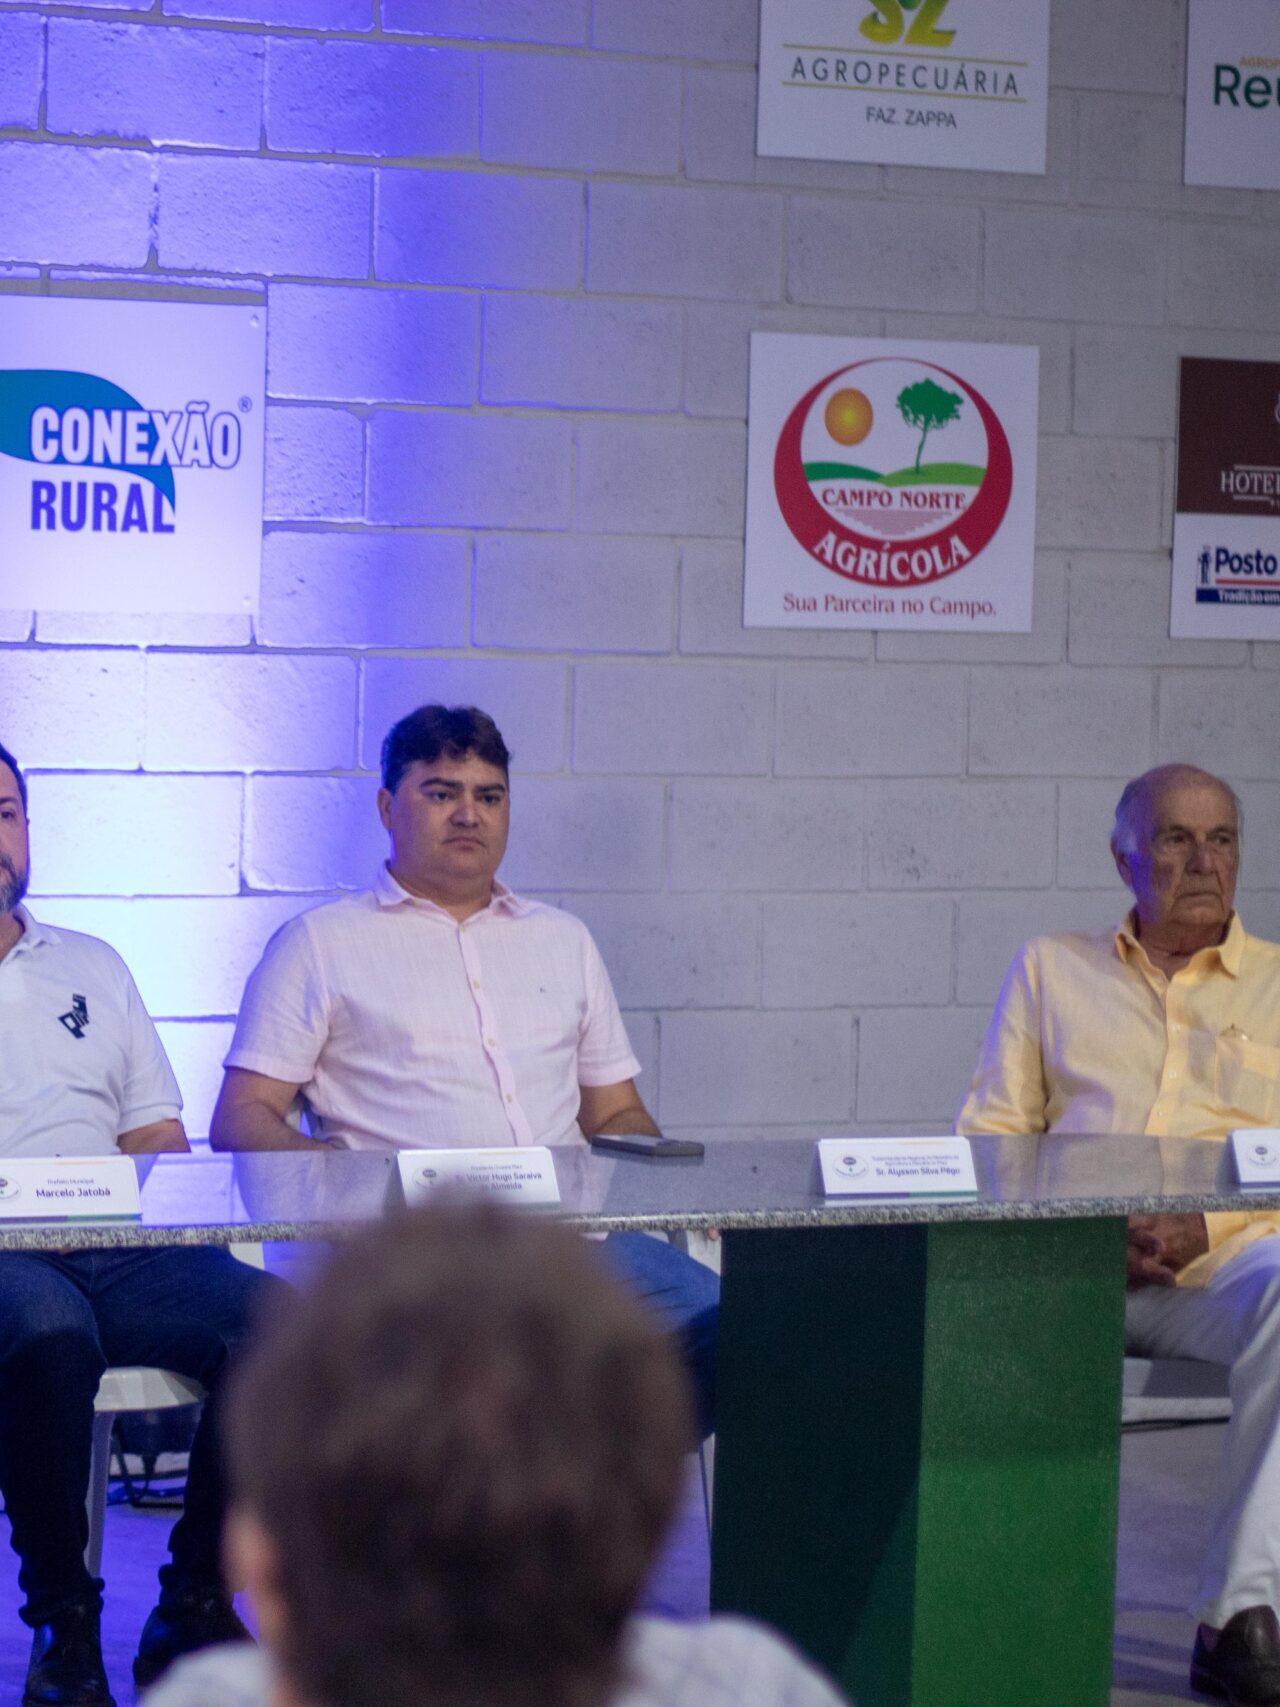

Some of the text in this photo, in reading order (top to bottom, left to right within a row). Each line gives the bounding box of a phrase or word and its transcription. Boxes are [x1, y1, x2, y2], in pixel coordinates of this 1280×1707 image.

[790, 57, 1020, 95] AGROPECUÁRIA
[1214, 63, 1280, 109] Re
[866, 105, 958, 130] FAZ. ZAPPA
[29, 400, 241, 470] CONEXÃO
[31, 480, 176, 533] RURAL
[822, 488, 966, 511] CAMPO NORTE
[814, 530, 972, 582] AGRÍCOLA
[1215, 548, 1277, 575] Posto
[783, 593, 817, 612] Sua
[824, 594, 895, 614] Parceira
[902, 600, 924, 615] no
[492, 1173, 512, 1182] Hugo
[888, 1167, 919, 1177] Alysson
[920, 1167, 939, 1175] Silva
[36, 1187, 74, 1198] Marcelo
